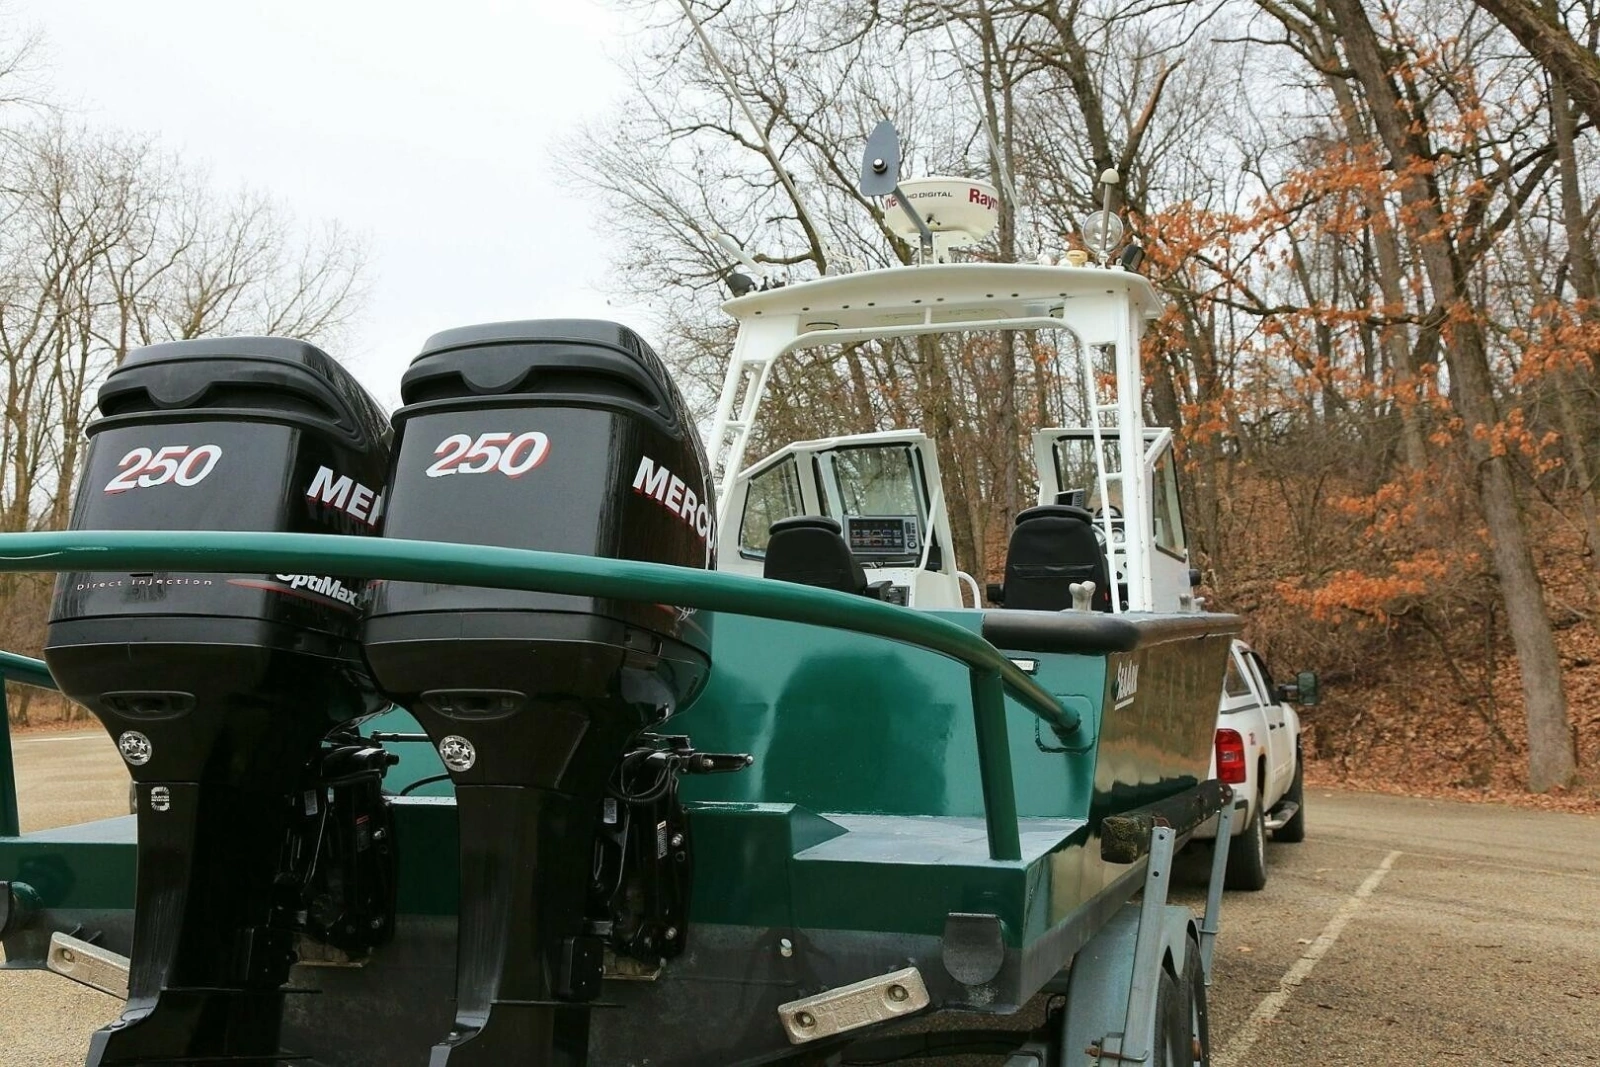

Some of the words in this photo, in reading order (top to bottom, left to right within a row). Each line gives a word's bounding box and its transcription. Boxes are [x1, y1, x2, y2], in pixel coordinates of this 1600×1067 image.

[918, 191, 953, 199] DIGITAL
[425, 431, 552, 479] 250
[103, 444, 223, 496] 250
[77, 580, 123, 591] Direct
